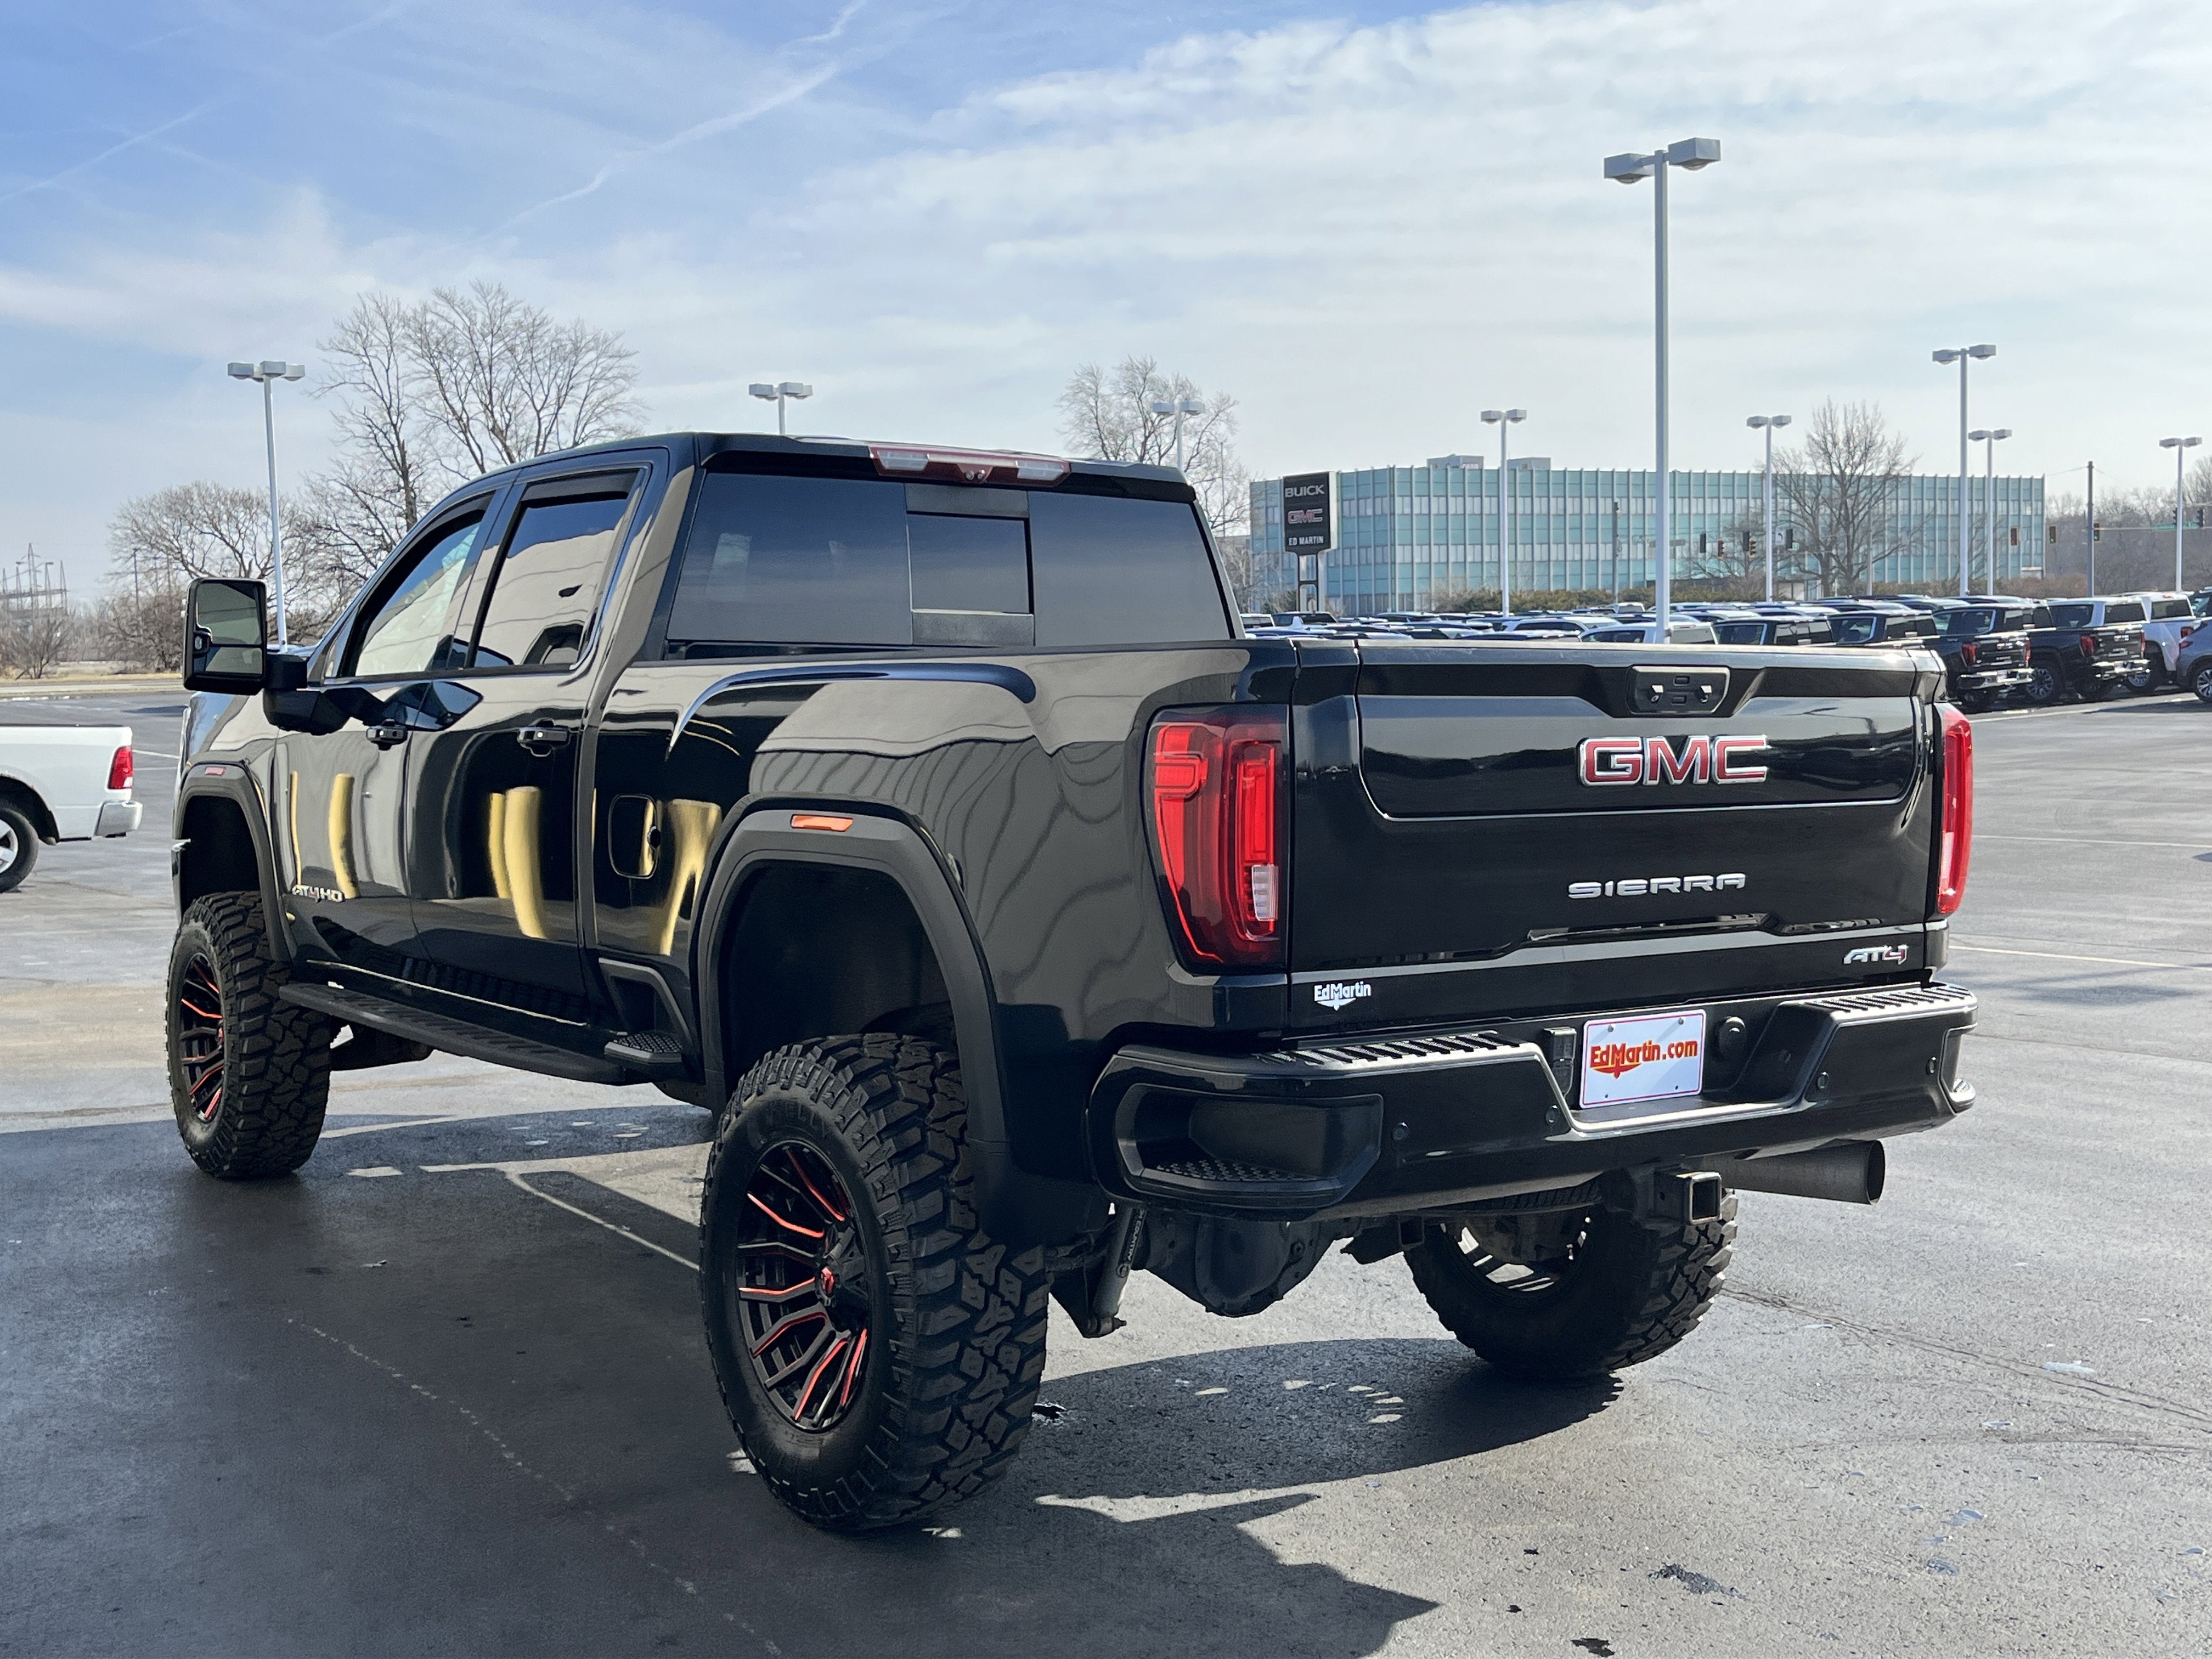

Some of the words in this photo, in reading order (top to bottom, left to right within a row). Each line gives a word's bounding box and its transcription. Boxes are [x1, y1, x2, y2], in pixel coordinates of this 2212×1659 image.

[1285, 484, 1325, 498] BUICK
[1288, 508, 1323, 524] GMC
[1289, 538, 1297, 546] ED
[1299, 535, 1324, 545] MARTIN
[1579, 735, 1768, 786] GMC
[1567, 873, 1746, 899] SIERRA
[1843, 944, 1909, 965] AT4
[1590, 1040, 1698, 1069] EdMartin.com
